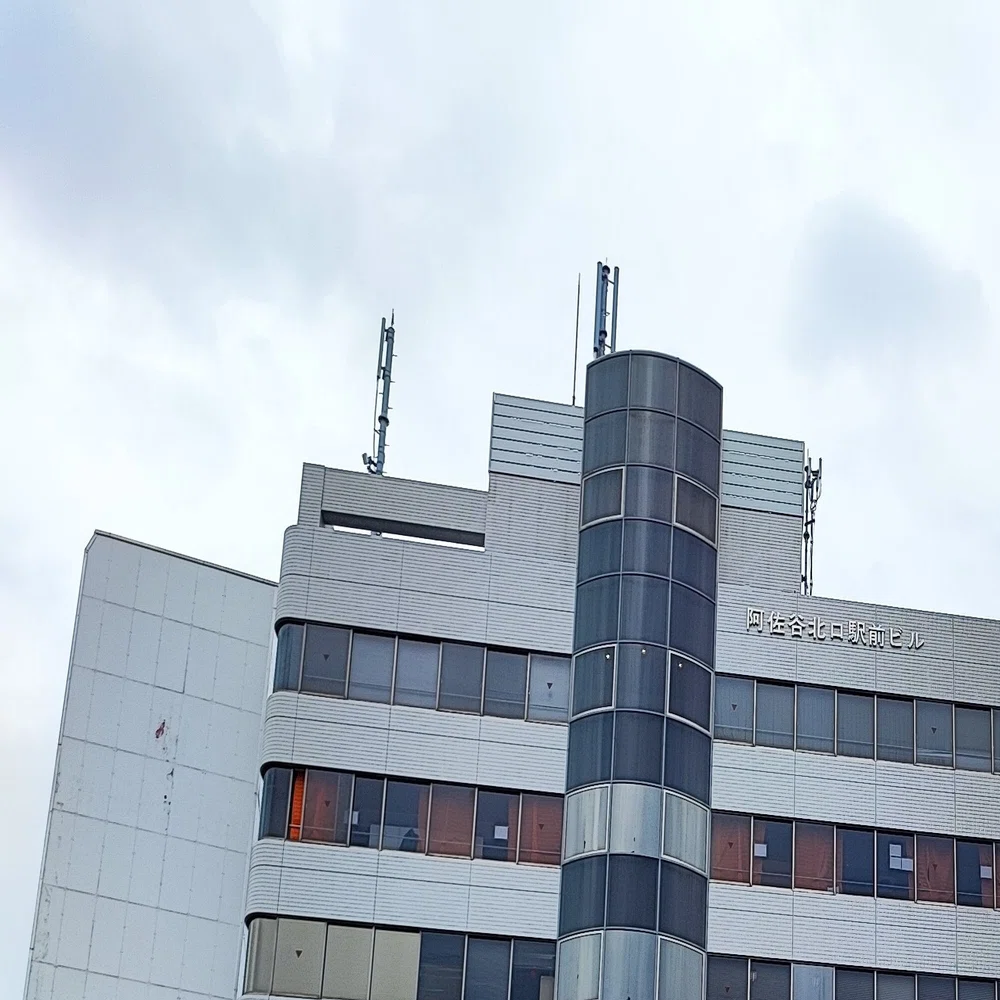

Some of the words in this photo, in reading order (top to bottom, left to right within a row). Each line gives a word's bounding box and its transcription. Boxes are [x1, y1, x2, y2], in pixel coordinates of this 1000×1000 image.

[746, 606, 925, 650] 阿佐谷北口駅前ビル
